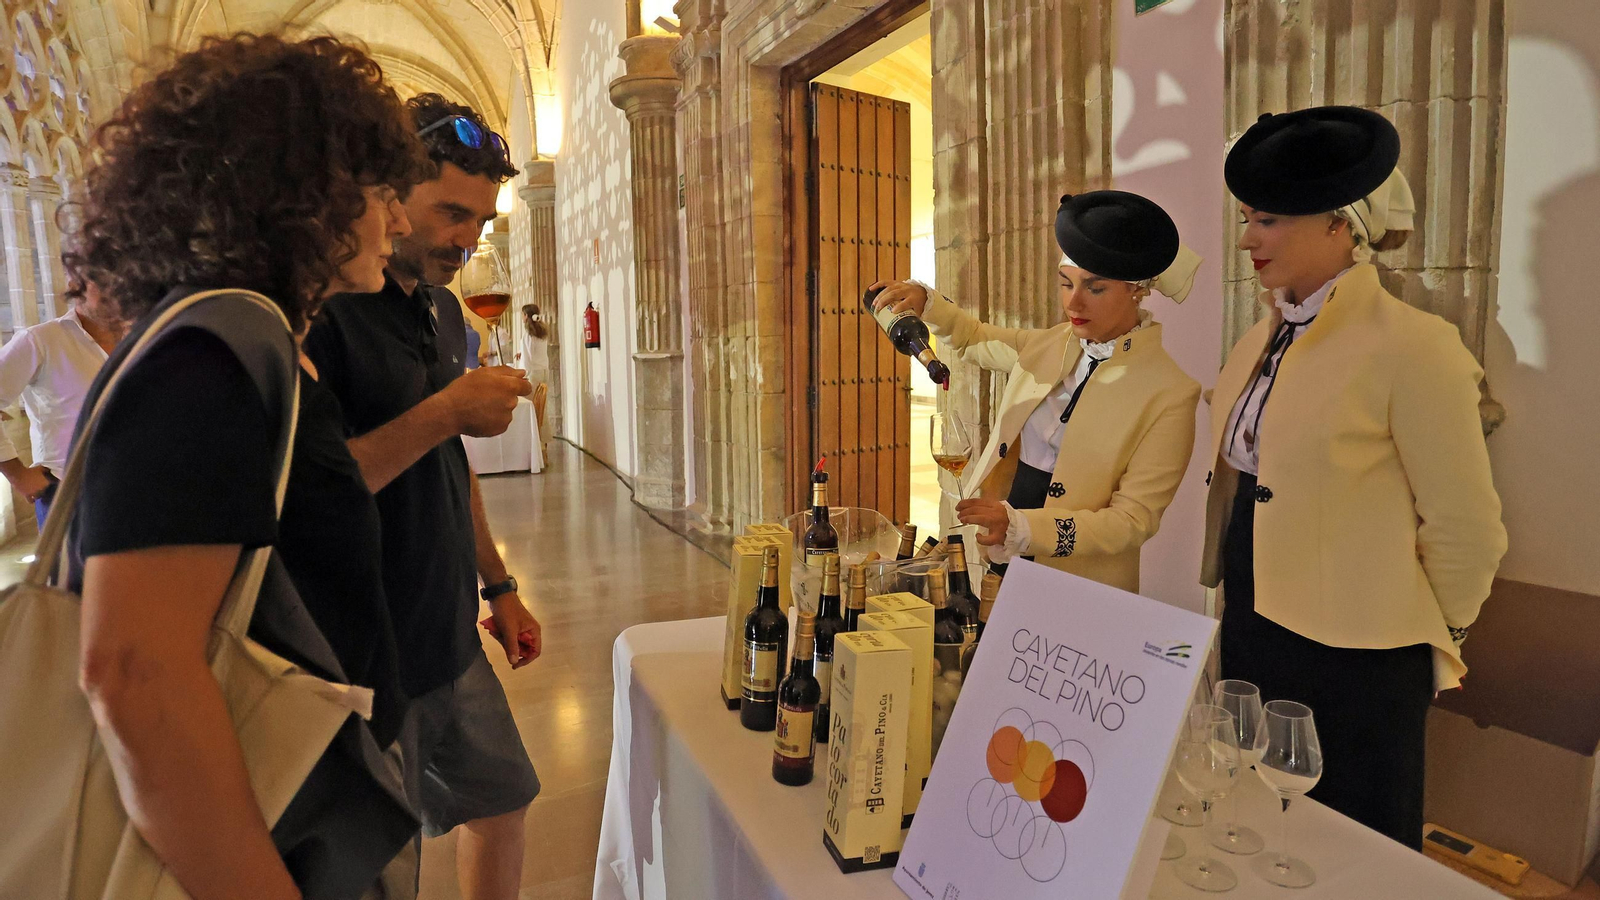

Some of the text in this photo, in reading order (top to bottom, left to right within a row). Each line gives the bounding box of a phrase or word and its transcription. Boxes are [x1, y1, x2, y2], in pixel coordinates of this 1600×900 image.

[1012, 628, 1146, 704] CAYETANO
[1007, 656, 1125, 732] DEL PINO
[832, 712, 847, 745] Pa
[874, 711, 887, 736] PINO
[830, 734, 840, 763] lo
[829, 761, 848, 790] cor
[870, 748, 884, 795] CAYETANO
[826, 805, 840, 835] do
